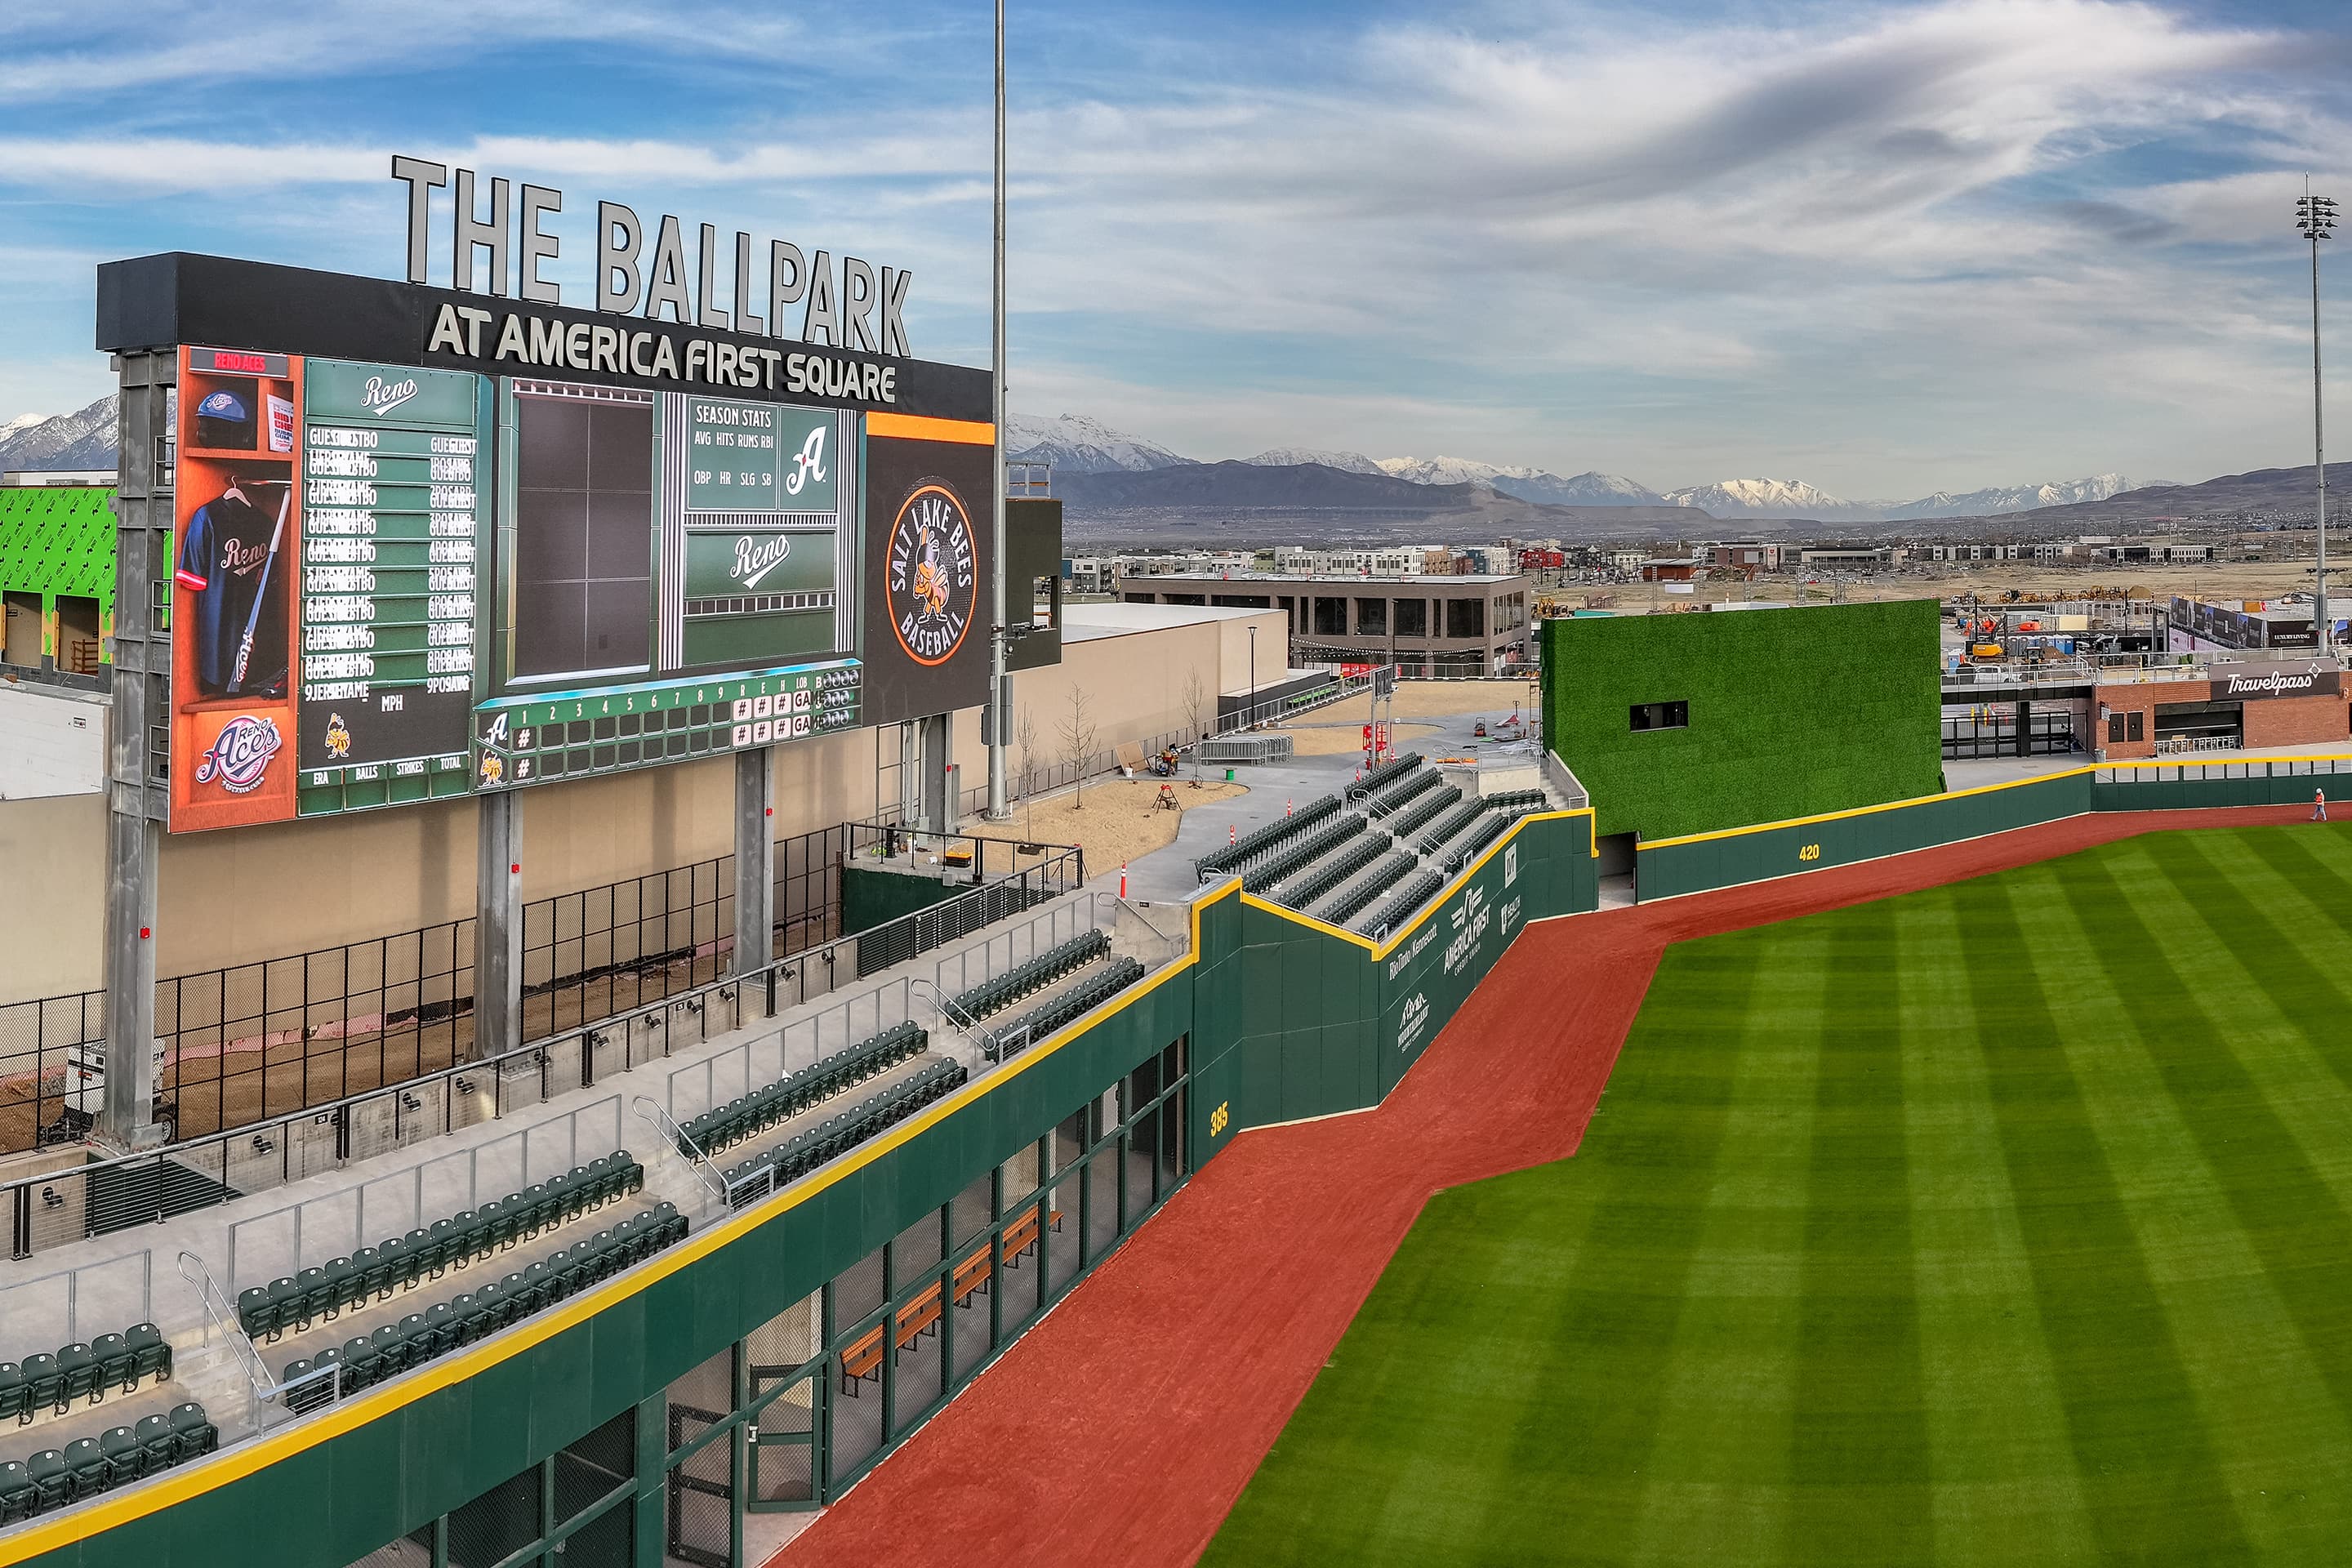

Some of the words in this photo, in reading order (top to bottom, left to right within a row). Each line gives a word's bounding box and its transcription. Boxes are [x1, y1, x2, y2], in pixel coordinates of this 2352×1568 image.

[392, 154, 562, 305] THE
[596, 199, 913, 358] BALLPARK
[214, 352, 240, 370] RENO
[240, 355, 266, 372] ACES
[428, 303, 492, 358] AT
[495, 313, 679, 380] AMERICA
[685, 339, 785, 390] FIRST
[786, 353, 897, 403] SQUARE
[359, 376, 419, 417] Reno
[696, 405, 739, 425] SEASON
[742, 409, 772, 429] STATS
[694, 431, 711, 446] AVG
[716, 432, 735, 447] HITS
[737, 434, 759, 448] RUNS
[761, 435, 774, 449] RBI
[694, 470, 711, 485] OBP
[719, 471, 732, 485] HR
[740, 473, 755, 486] SLG
[761, 473, 772, 487] SB
[786, 425, 827, 496] A
[220, 537, 269, 569] Reno
[729, 534, 791, 590] Reno
[891, 523, 913, 592] SALT
[911, 499, 951, 533] LAKE
[950, 521, 972, 589] BEES
[900, 611, 964, 657] BASEBALL
[522, 710, 528, 724] 1
[550, 706, 556, 720] 2
[576, 703, 582, 717] 3
[602, 700, 608, 714] 4
[627, 697, 633, 710] 5
[651, 695, 657, 708] 6
[675, 692, 679, 705] 7
[697, 689, 703, 702] 8
[718, 687, 724, 700] 9
[740, 684, 746, 696] R
[760, 682, 766, 694] E
[780, 679, 786, 692] H
[795, 676, 808, 689] LOB
[815, 676, 822, 688] B
[2227, 670, 2313, 696] Travelpass
[381, 695, 403, 712] MPH
[239, 718, 269, 740] RENO
[518, 728, 531, 748] #
[194, 724, 283, 784] Aces
[313, 772, 328, 785] ERA
[355, 765, 378, 780] BALLS
[396, 760, 424, 775] STRIKES
[439, 755, 461, 770] TOTAL
[517, 758, 530, 778] #
[1799, 844, 1820, 862] 420
[1412, 923, 1437, 959] Kennecott
[1444, 923, 1473, 975] AMERICA
[1472, 903, 1490, 942] FIRST
[1454, 954, 1469, 977] CREDIT
[1469, 941, 1481, 960] UNION
[1210, 1100, 1228, 1138] 385
